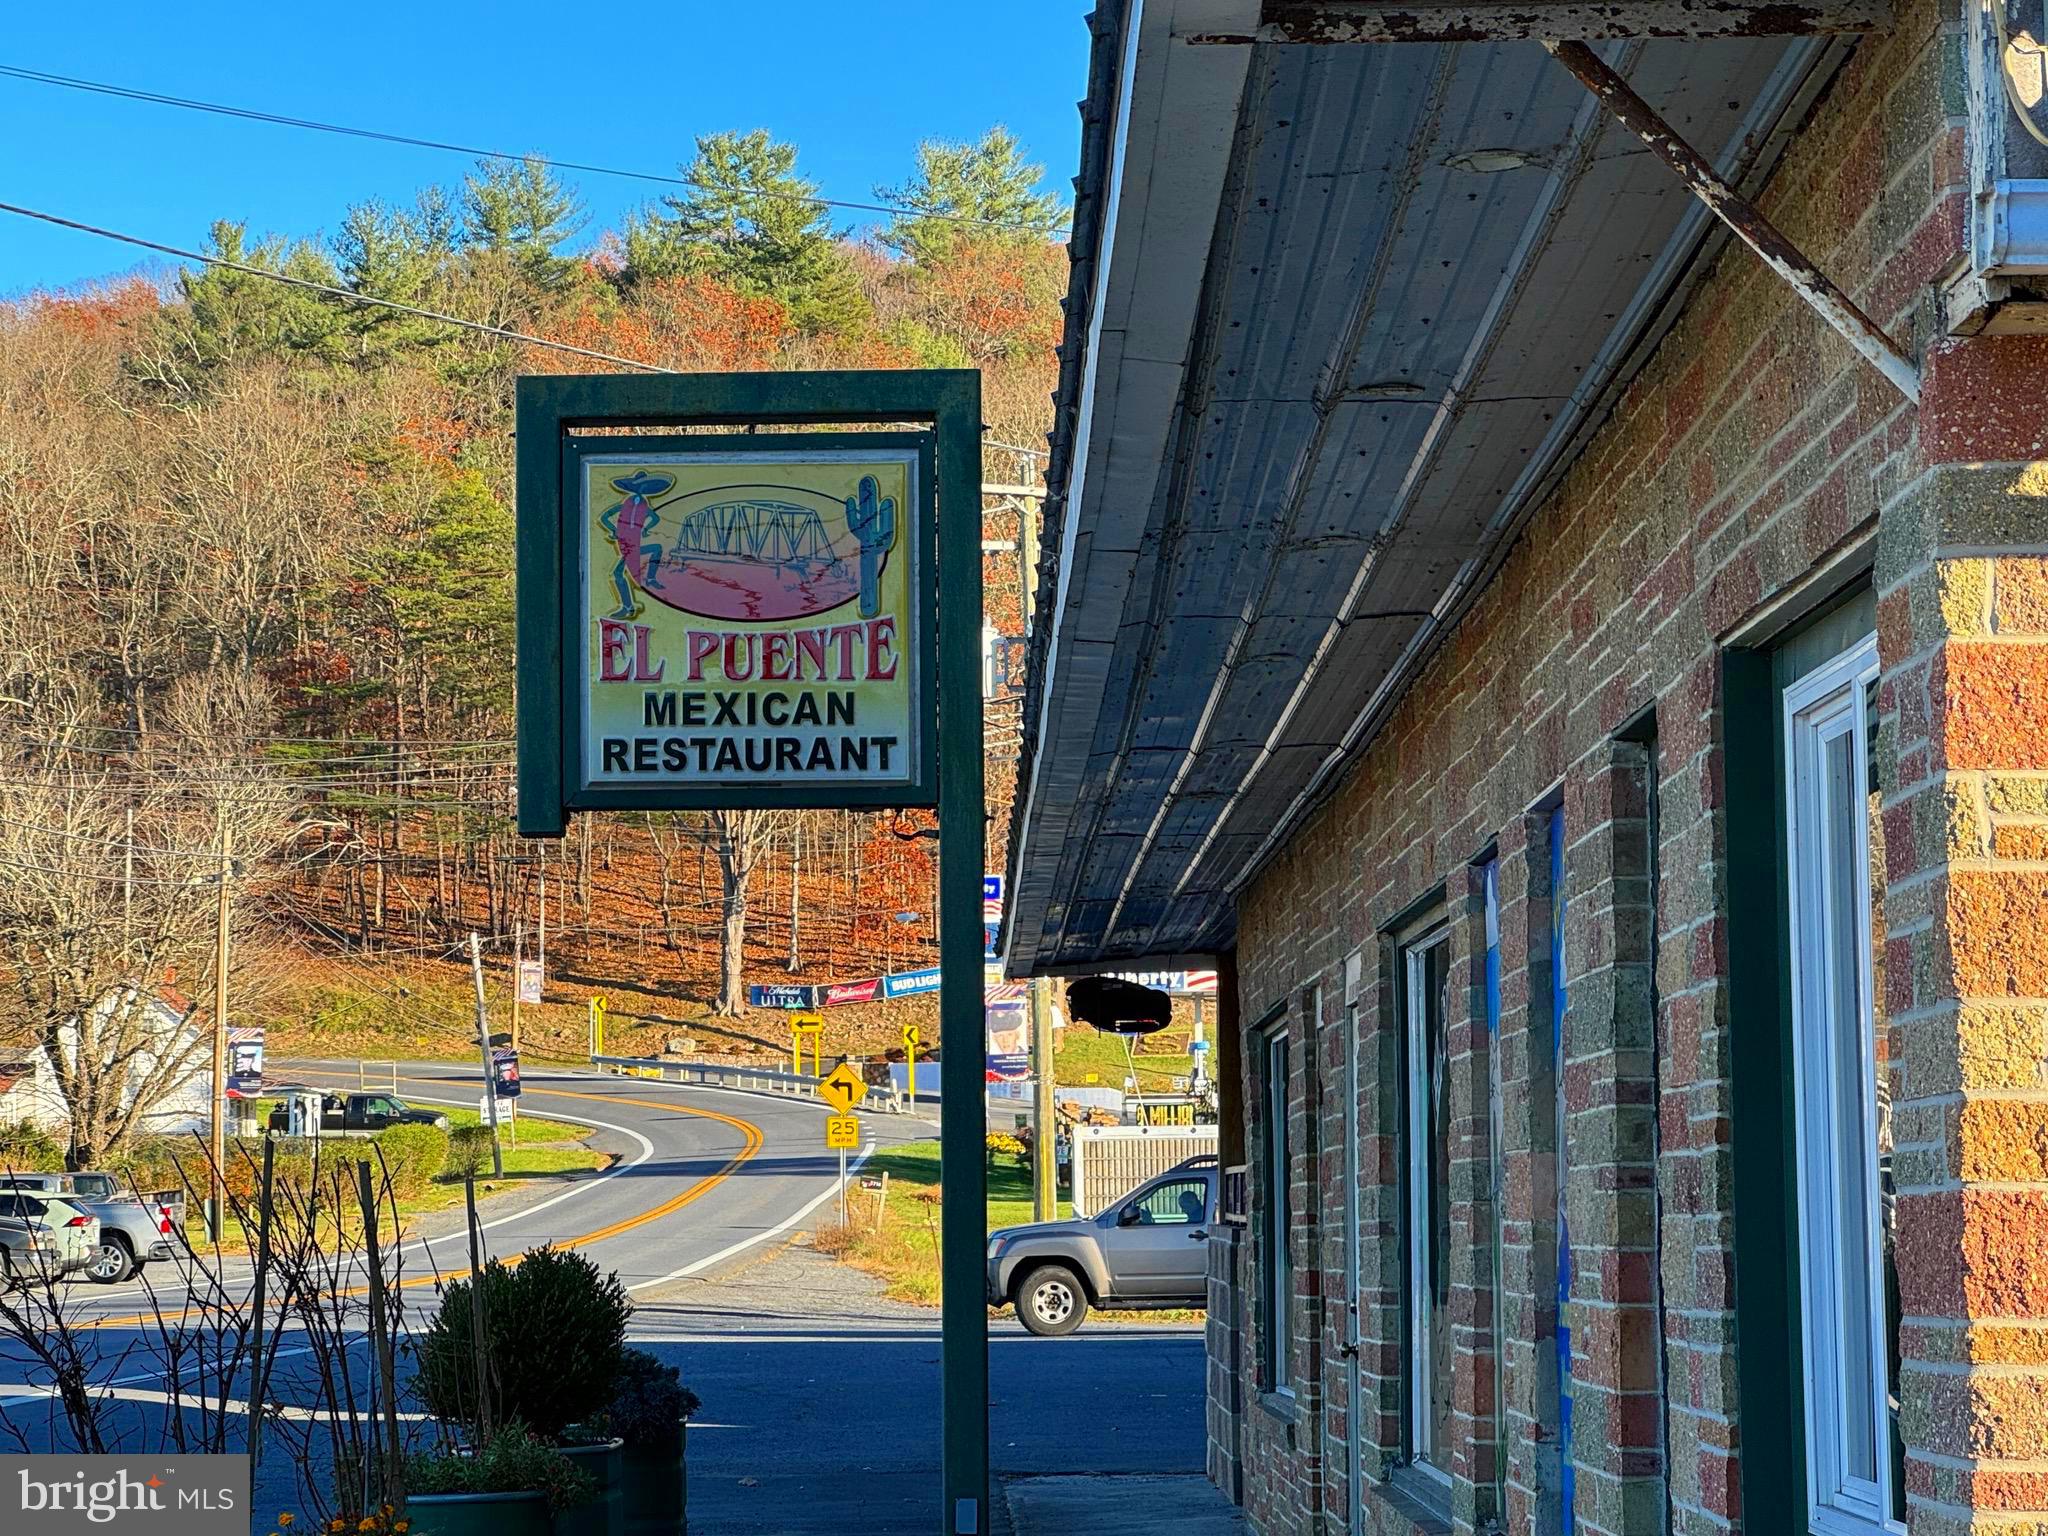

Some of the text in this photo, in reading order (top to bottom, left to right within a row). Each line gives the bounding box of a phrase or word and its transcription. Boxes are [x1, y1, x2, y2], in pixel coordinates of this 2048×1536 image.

[599, 616, 898, 682] EL PUENTE
[643, 691, 855, 726] MEXICAN
[602, 737, 897, 771] RESTAURANT
[891, 974, 941, 991] BUD LIGH
[761, 995, 805, 1007] ULTRA
[827, 986, 876, 999] Budweiser
[831, 1121, 855, 1135] 25
